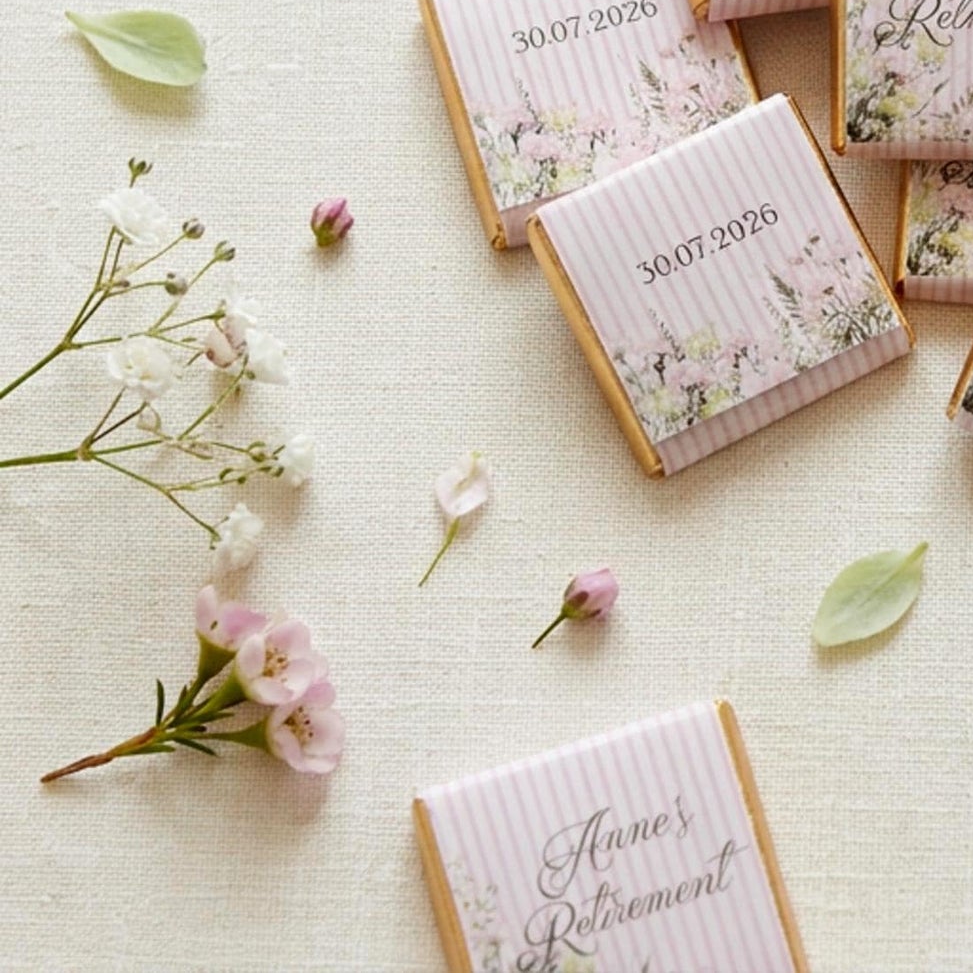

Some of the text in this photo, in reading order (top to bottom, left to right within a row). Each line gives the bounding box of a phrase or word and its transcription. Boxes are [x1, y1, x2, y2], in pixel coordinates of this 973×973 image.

[635, 202, 780, 285] 30.07.2026
[536, 795, 696, 900] Anne's
[515, 838, 749, 973] Retirement
